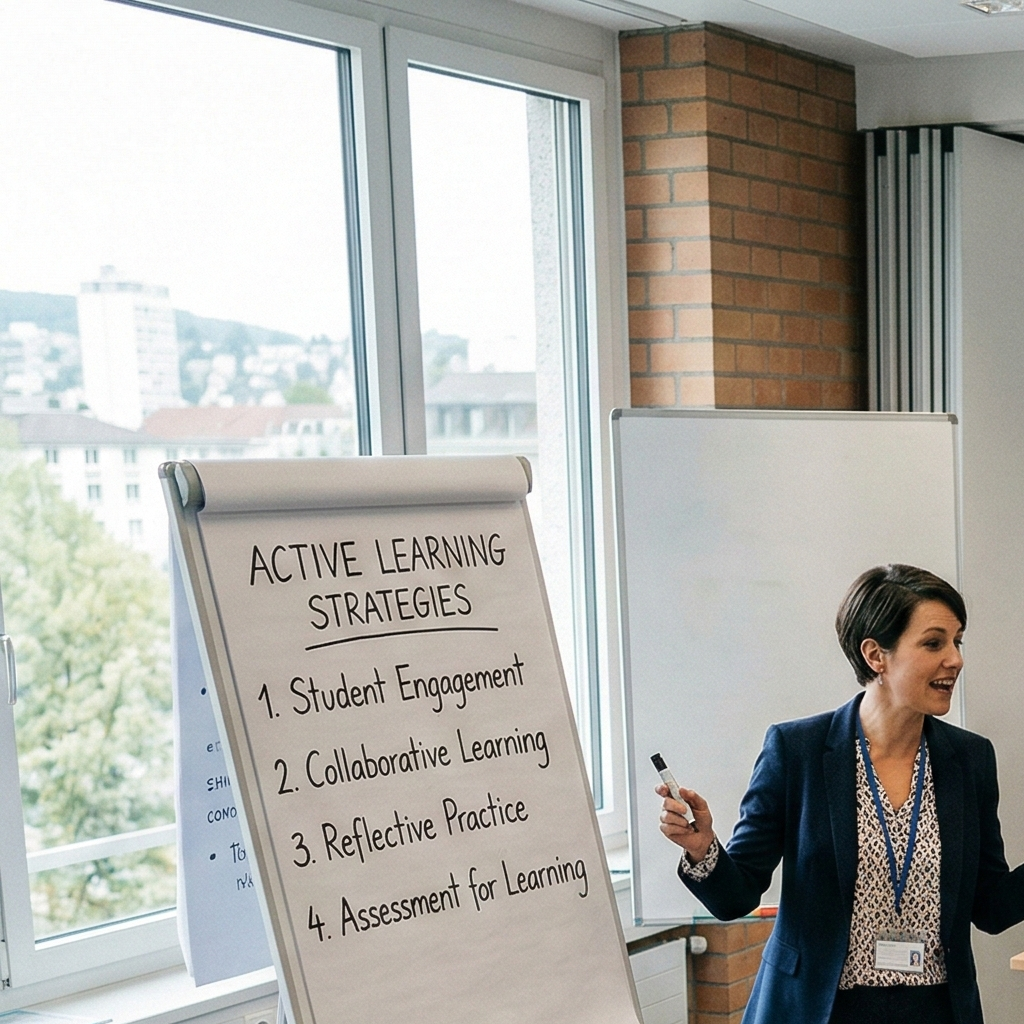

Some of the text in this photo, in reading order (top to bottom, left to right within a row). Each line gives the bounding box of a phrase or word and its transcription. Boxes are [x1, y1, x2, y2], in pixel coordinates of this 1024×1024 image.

[249, 533, 507, 586] ACTIVE LEARNING
[308, 583, 473, 630] STRATEGIES
[257, 652, 526, 719] 1. Student Engagement
[274, 727, 551, 795] 2. Collaborative Learning
[291, 792, 530, 868] 3. Reflective Practice
[308, 856, 589, 942] 4. Assessment for Learning
